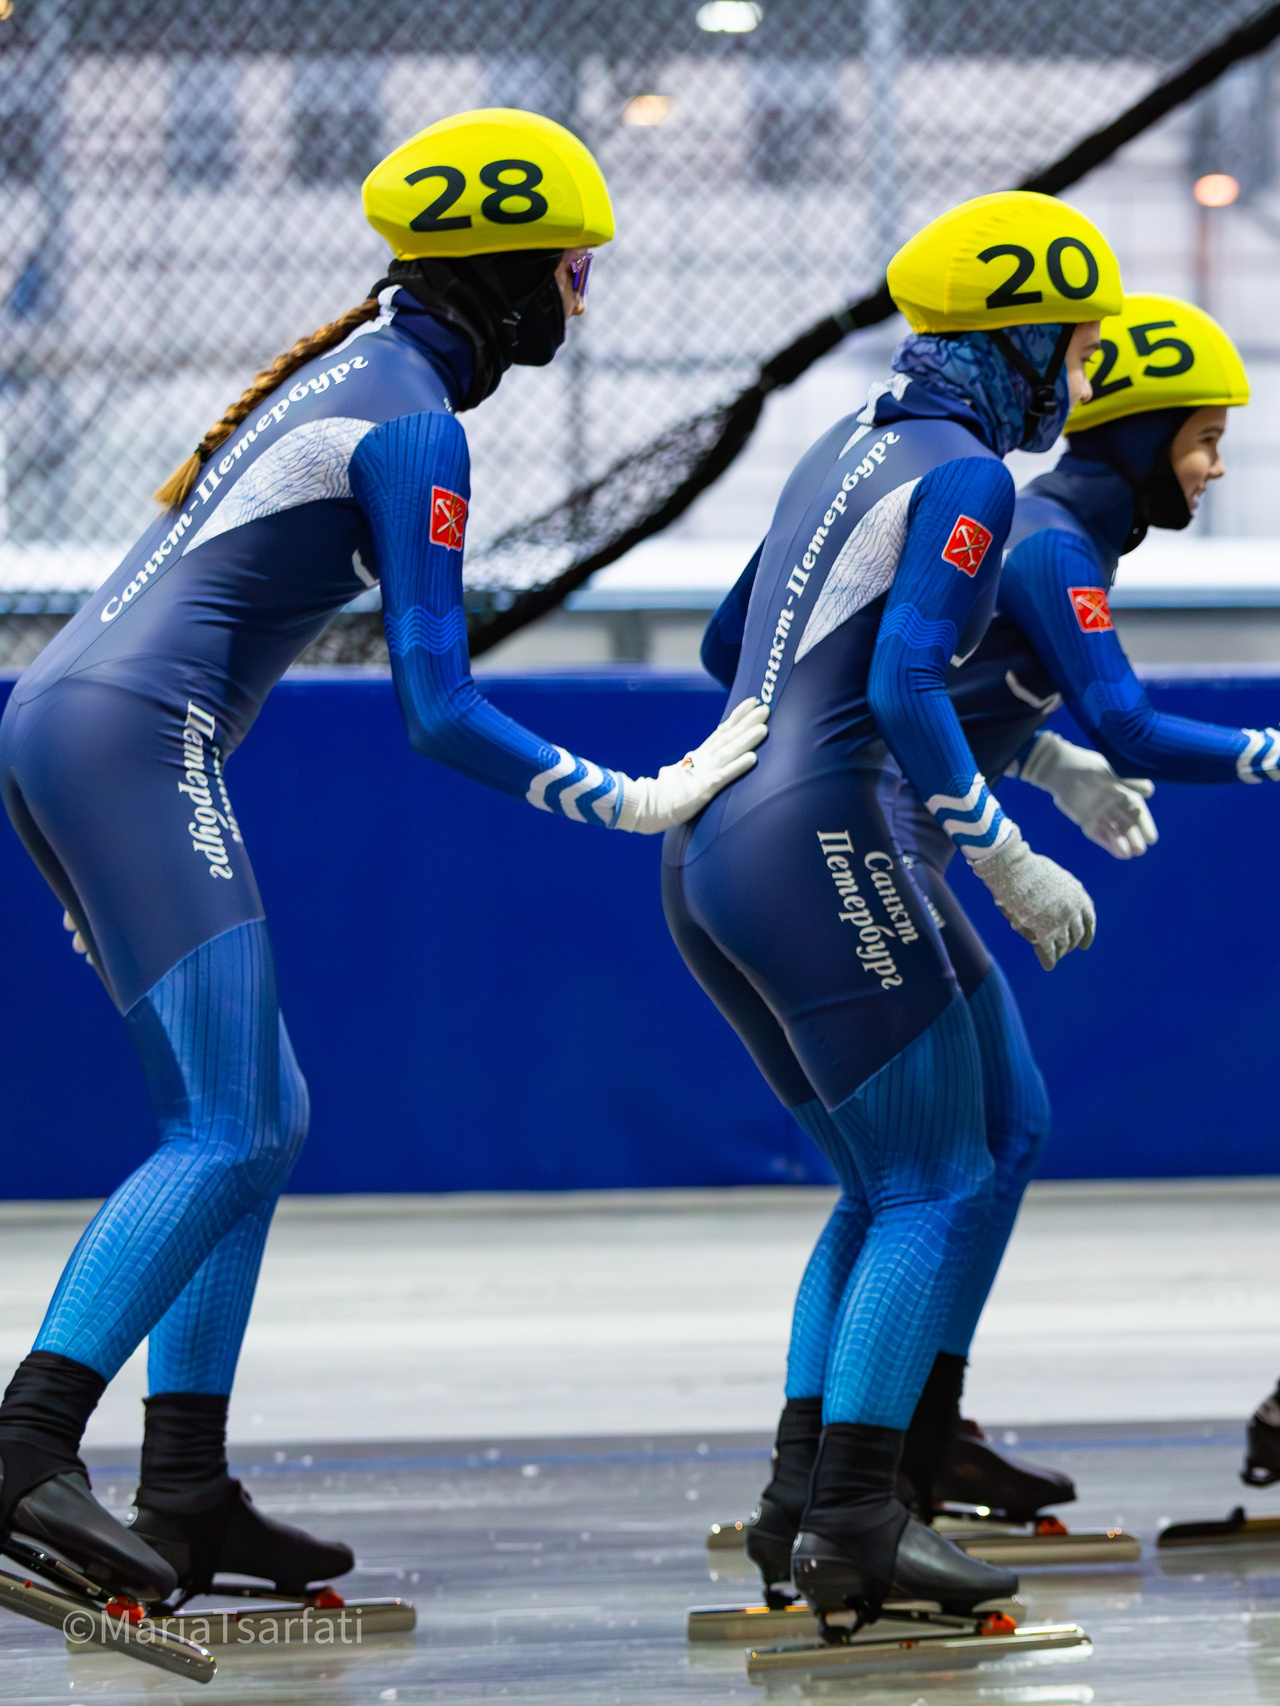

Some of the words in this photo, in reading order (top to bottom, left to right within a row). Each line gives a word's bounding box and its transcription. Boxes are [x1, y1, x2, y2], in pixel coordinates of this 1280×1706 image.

[403, 158, 549, 233] 28
[976, 236, 1099, 310] 20
[1081, 320, 1195, 405] 25
[100, 354, 369, 624] Санкт-Петербург
[760, 430, 900, 704] анкт-Петербург
[178, 699, 234, 880] Петербург
[816, 829, 903, 990] Петербург
[864, 850, 919, 945] Санкт
